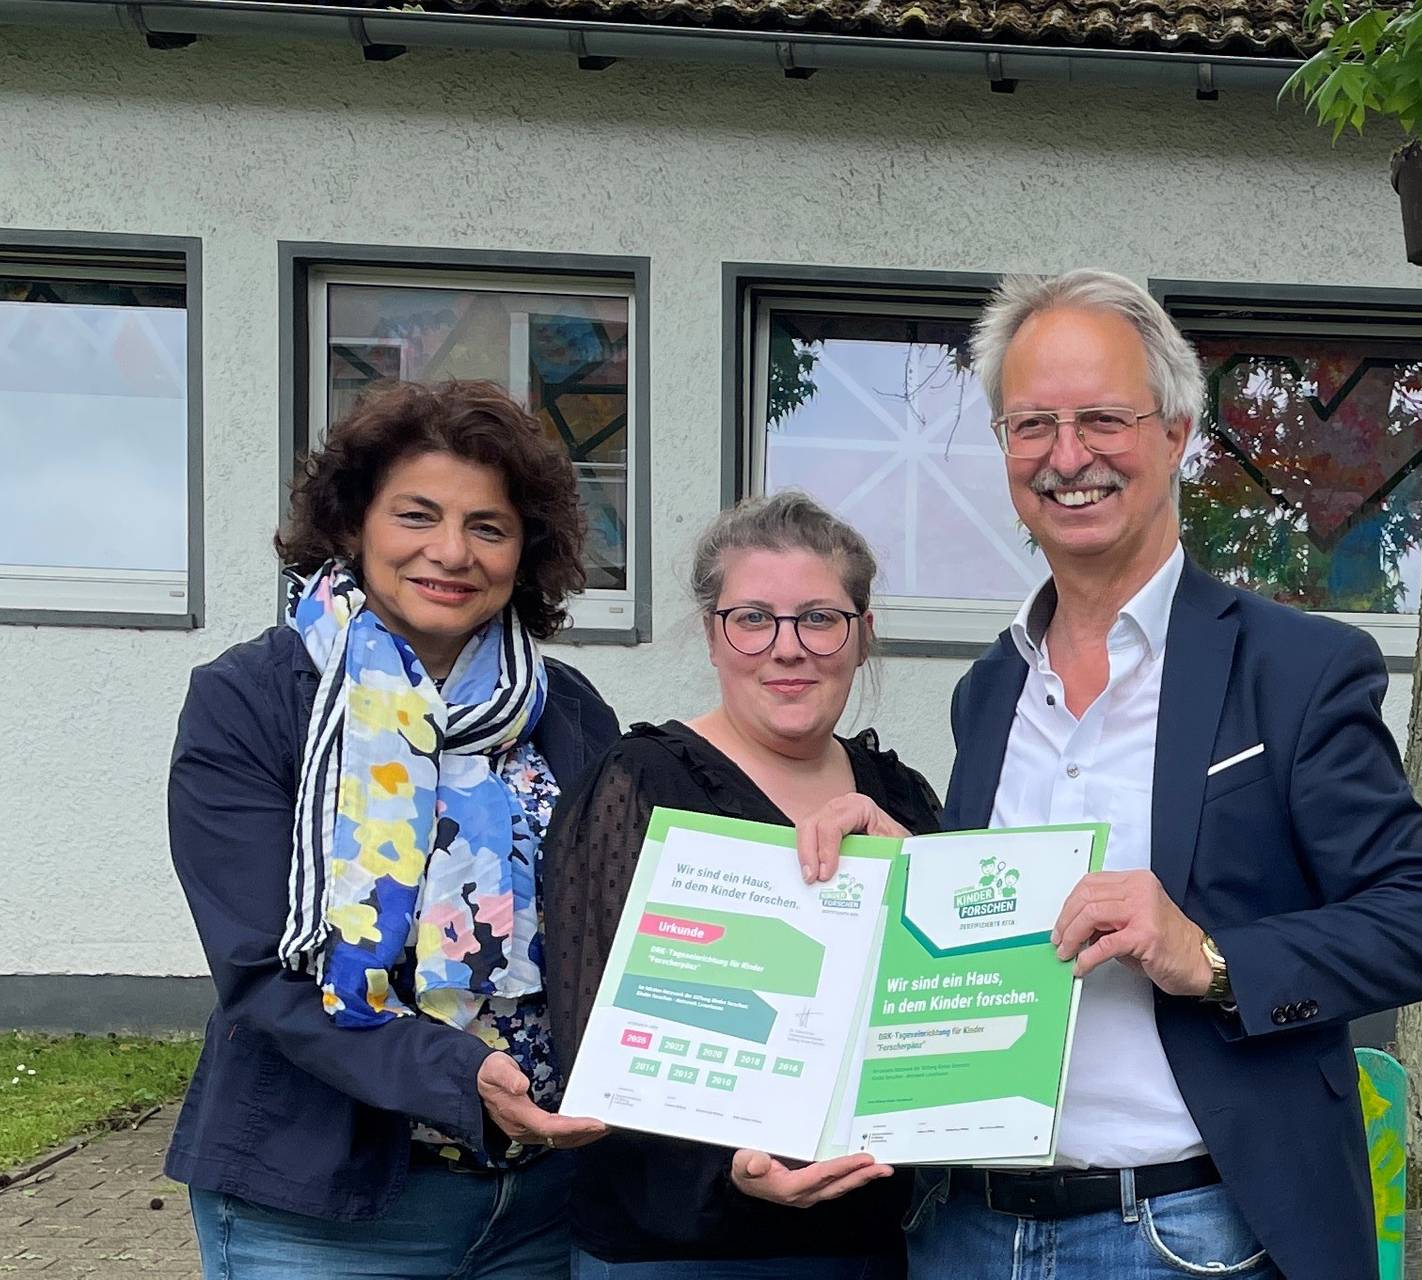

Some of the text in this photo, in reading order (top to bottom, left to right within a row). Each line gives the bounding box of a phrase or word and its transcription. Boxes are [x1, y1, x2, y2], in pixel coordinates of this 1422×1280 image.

[676, 863, 773, 891] Wir sind ein Haus,
[671, 877, 800, 910] in dem Kinder forschen.
[956, 888, 993, 907] KINDER
[961, 900, 1014, 918] FORSCHEN
[658, 921, 705, 939] Urkunde
[887, 971, 1003, 992] Wir sind ein Haus,
[883, 989, 1039, 1014] in dem Kinder forschen.
[634, 1062, 656, 1073] 2014
[672, 1068, 694, 1080] 2012
